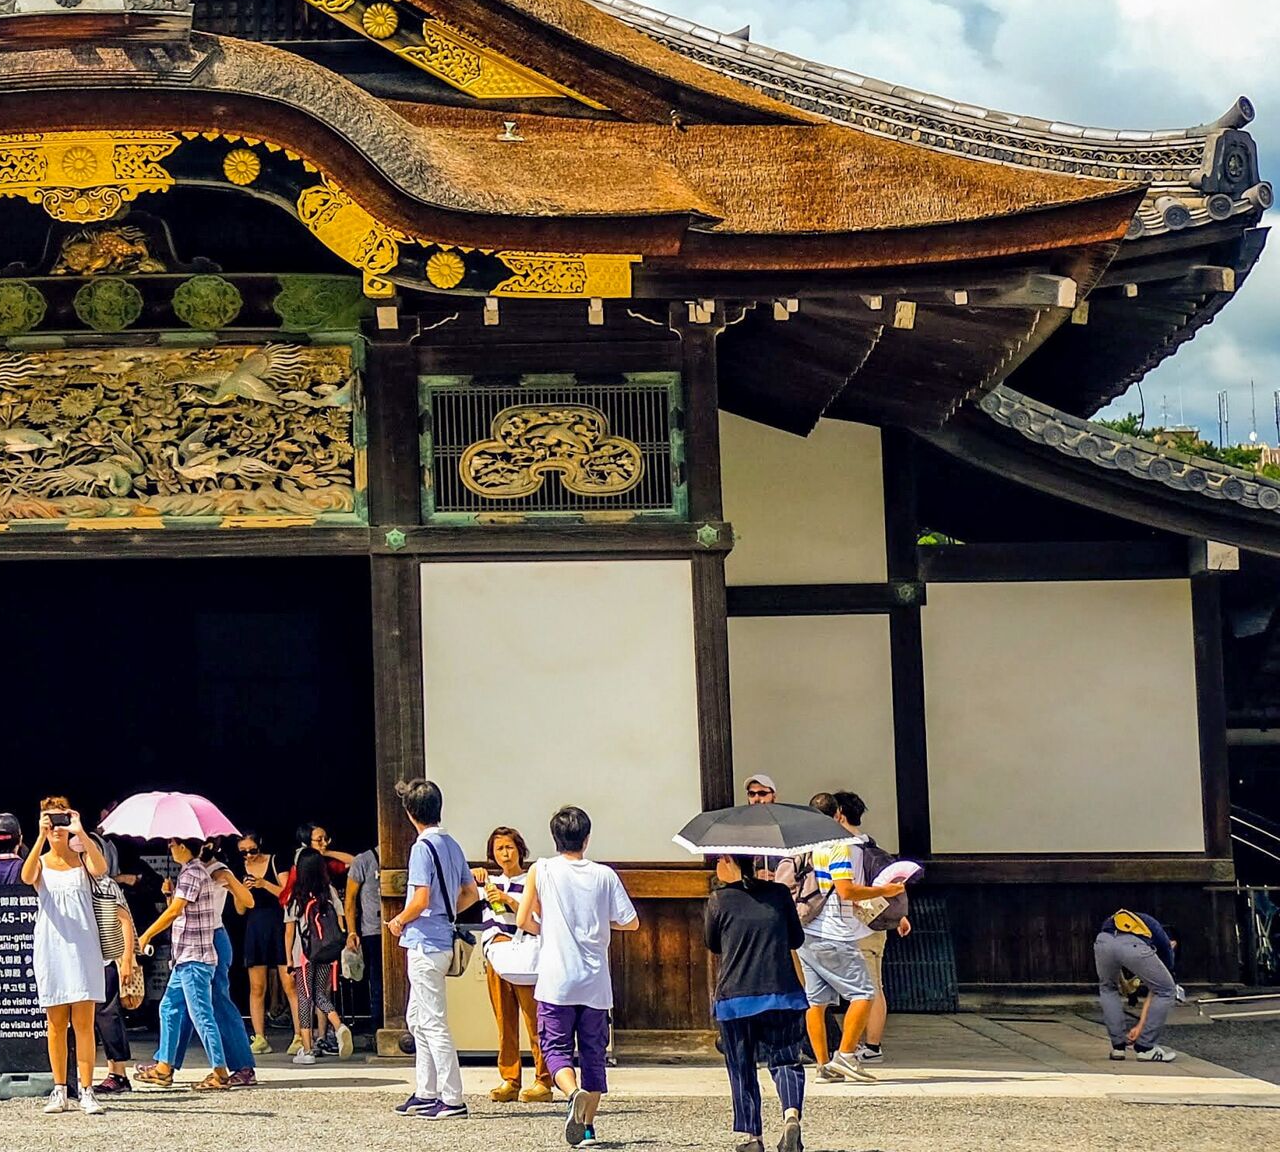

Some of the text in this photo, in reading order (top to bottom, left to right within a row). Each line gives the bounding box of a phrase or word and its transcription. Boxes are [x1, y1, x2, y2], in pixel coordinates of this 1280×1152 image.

[2, 997, 11, 1006] de
[12, 997, 32, 1006] visite
[1, 1021, 10, 1029] de
[11, 1021, 30, 1029] visita
[31, 1020, 43, 1028] del
